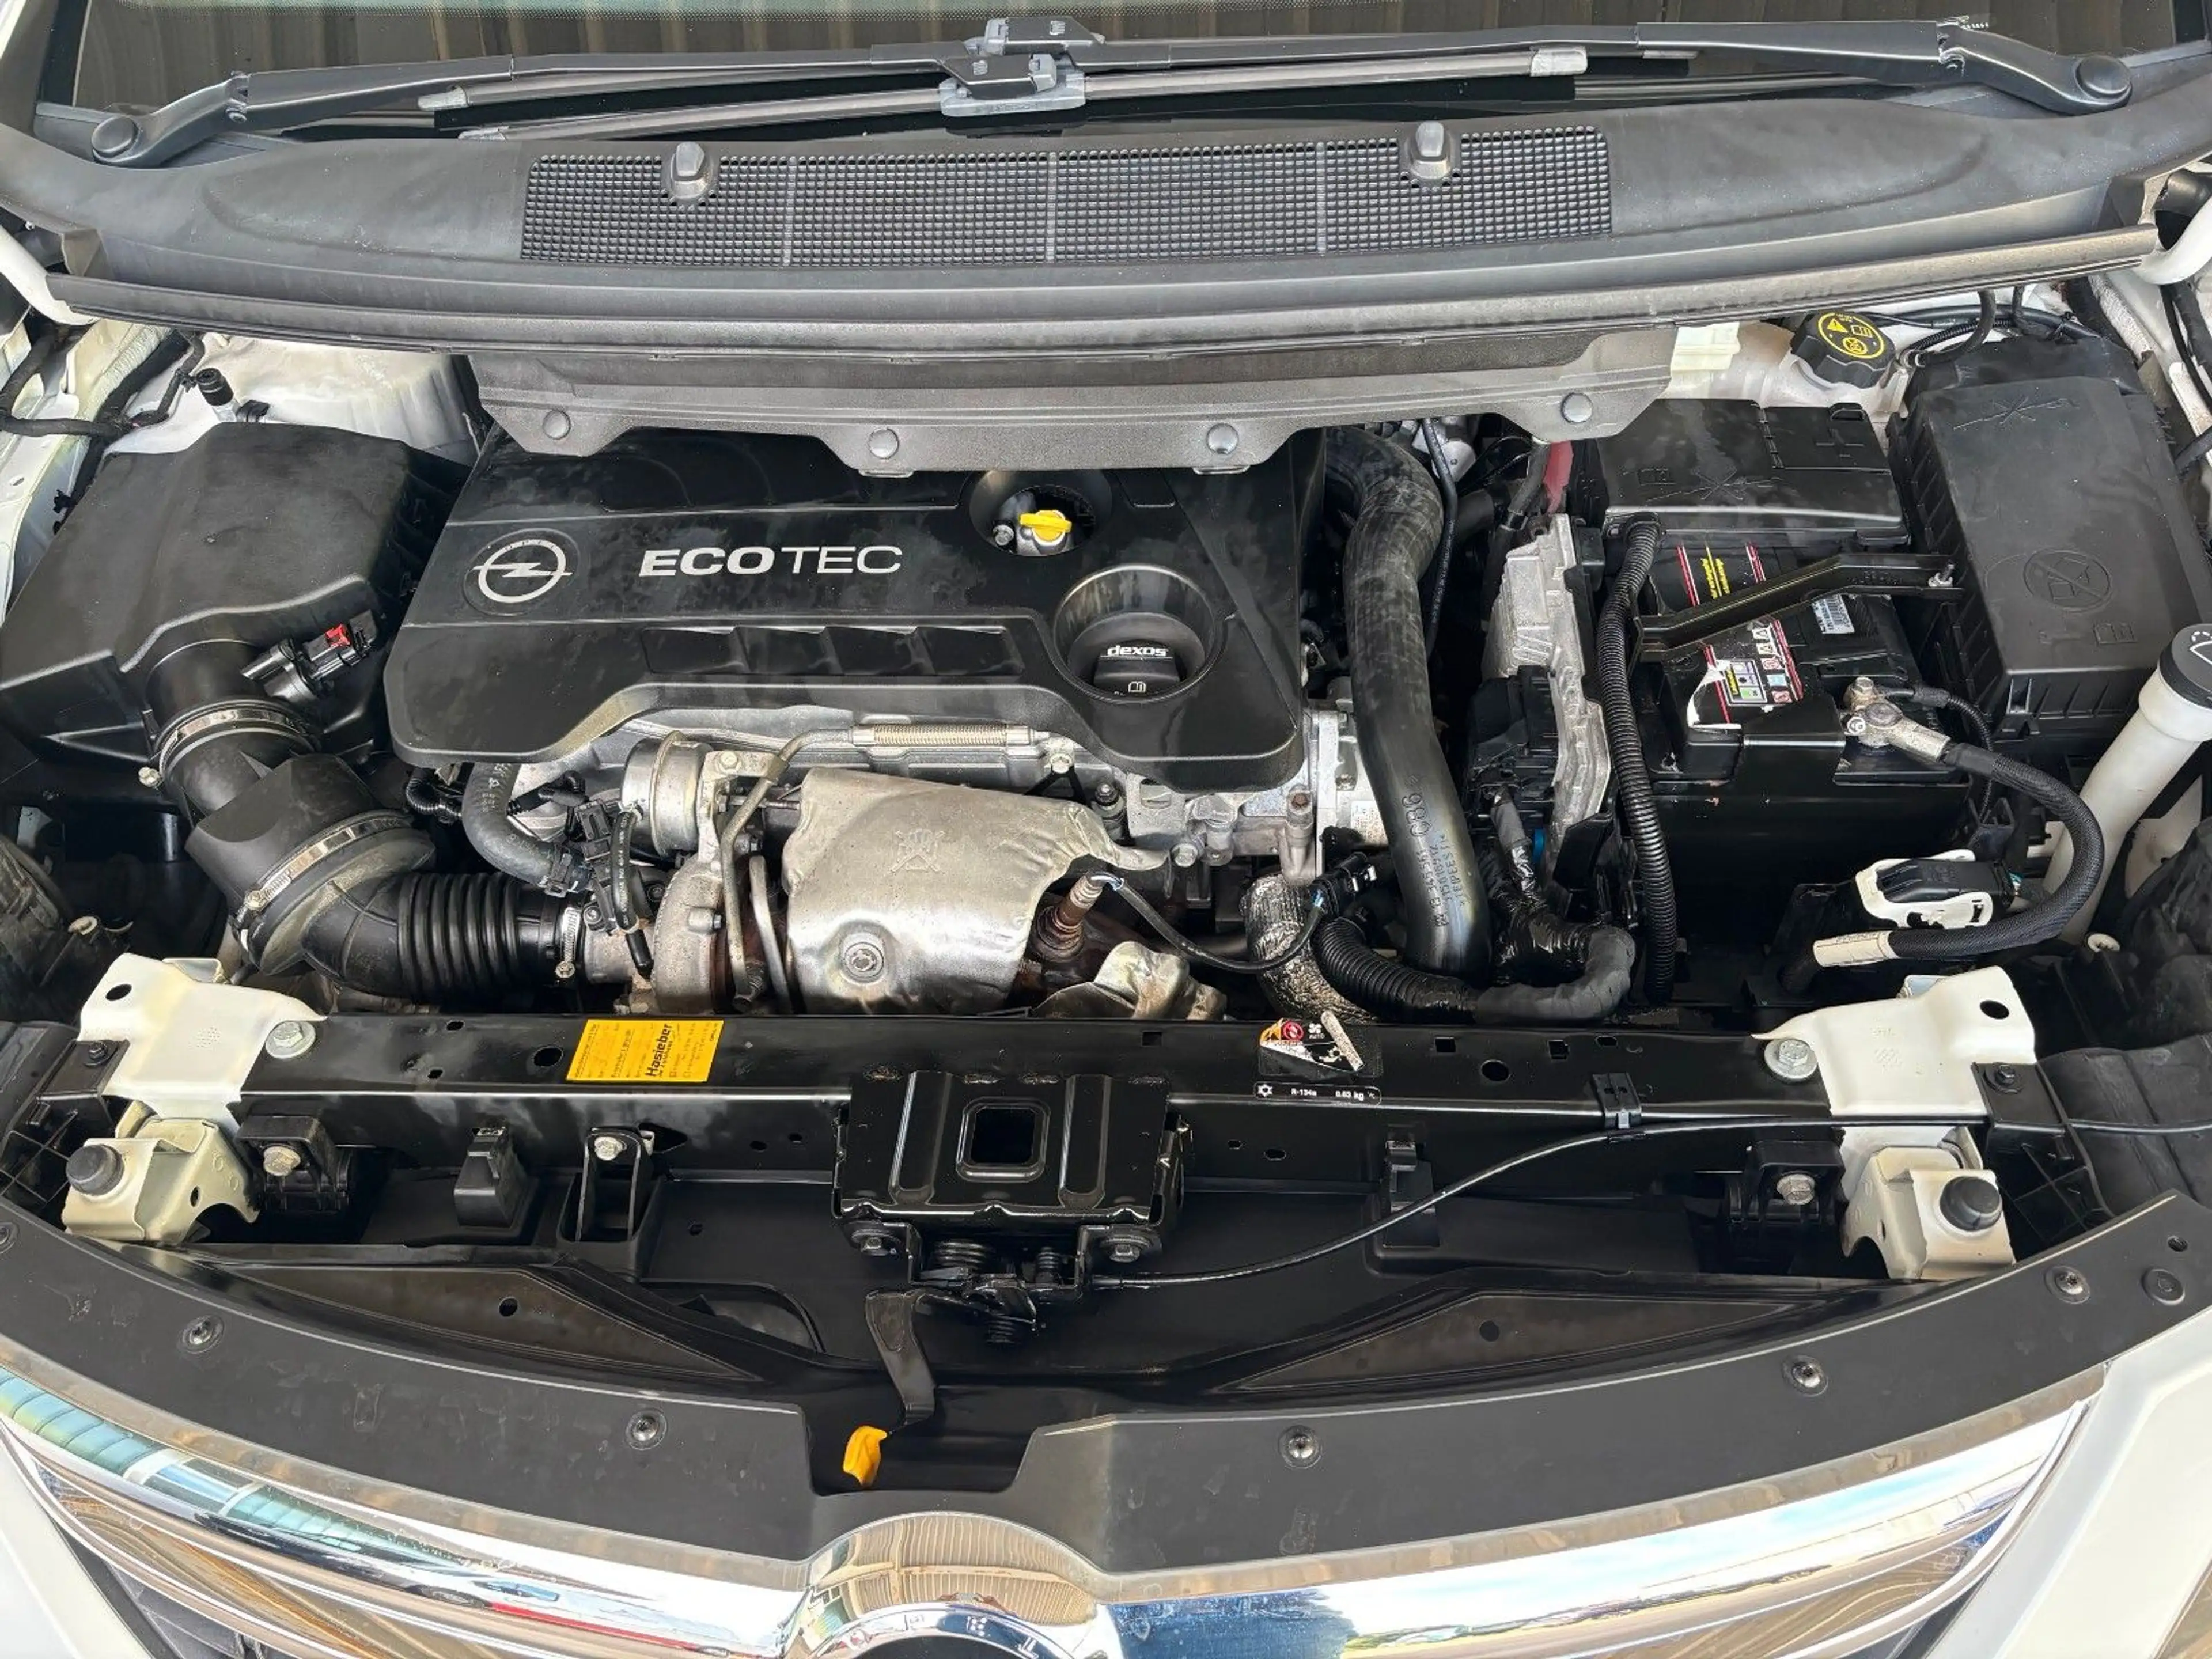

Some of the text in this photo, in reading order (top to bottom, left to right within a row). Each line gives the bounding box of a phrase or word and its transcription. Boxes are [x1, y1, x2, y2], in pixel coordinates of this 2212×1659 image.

[639, 545, 903, 576] ECOTEC
[1107, 645, 1169, 657] dexos
[1291, 1088, 1317, 1096] R-134a
[1354, 1090, 1365, 1101] kg
